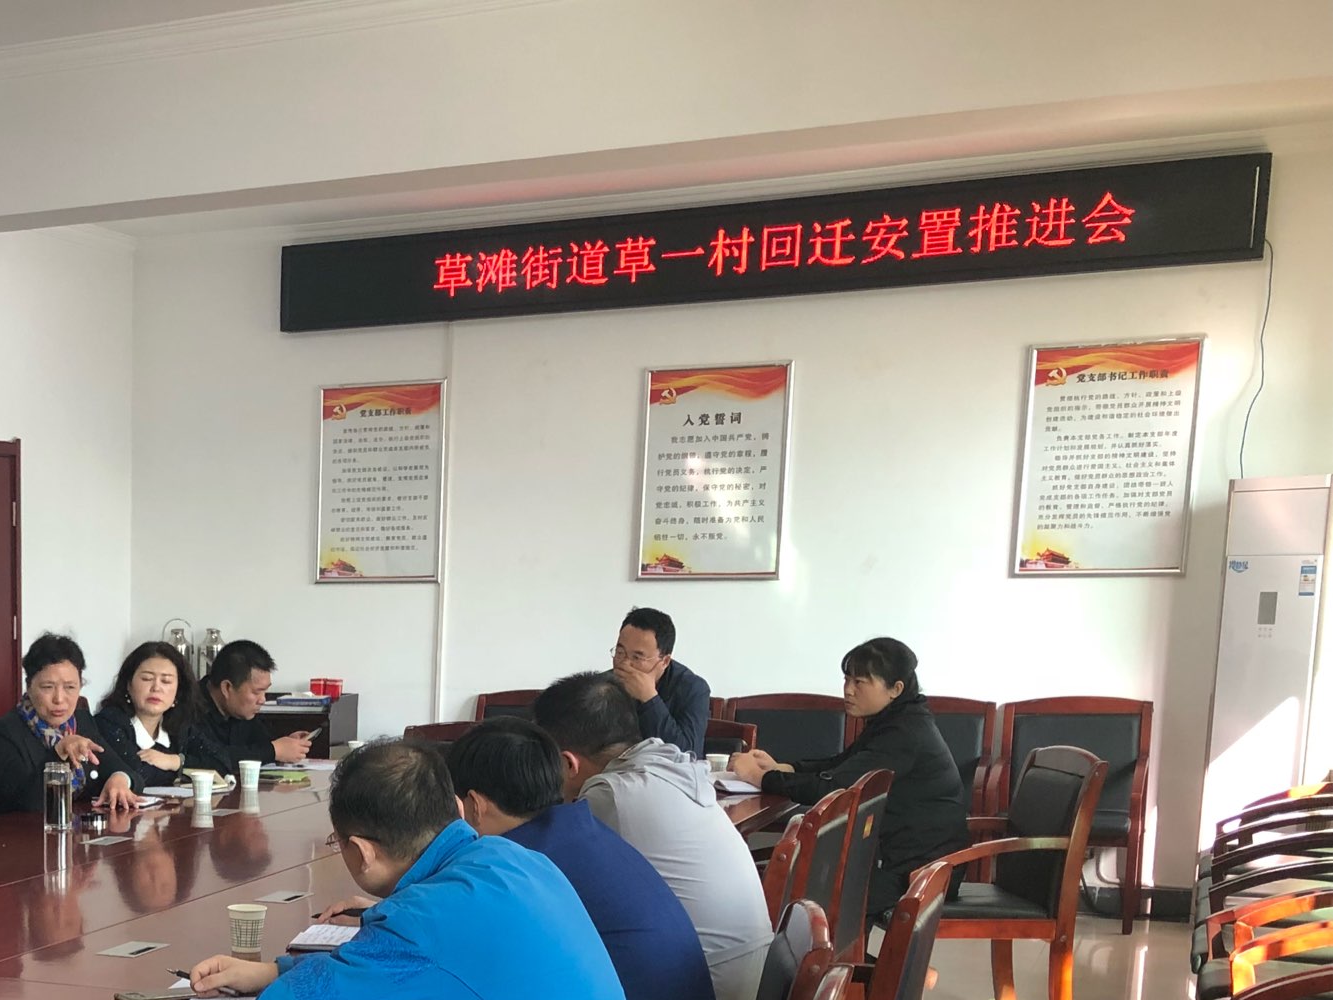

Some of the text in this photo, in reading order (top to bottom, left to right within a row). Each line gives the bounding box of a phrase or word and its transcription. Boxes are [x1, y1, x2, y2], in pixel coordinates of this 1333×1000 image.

[433, 191, 1135, 297] 草滩街道草一村回迁安置推进会
[1076, 370, 1169, 384] 党支部书记工作职责
[683, 412, 742, 426] 入党誓词
